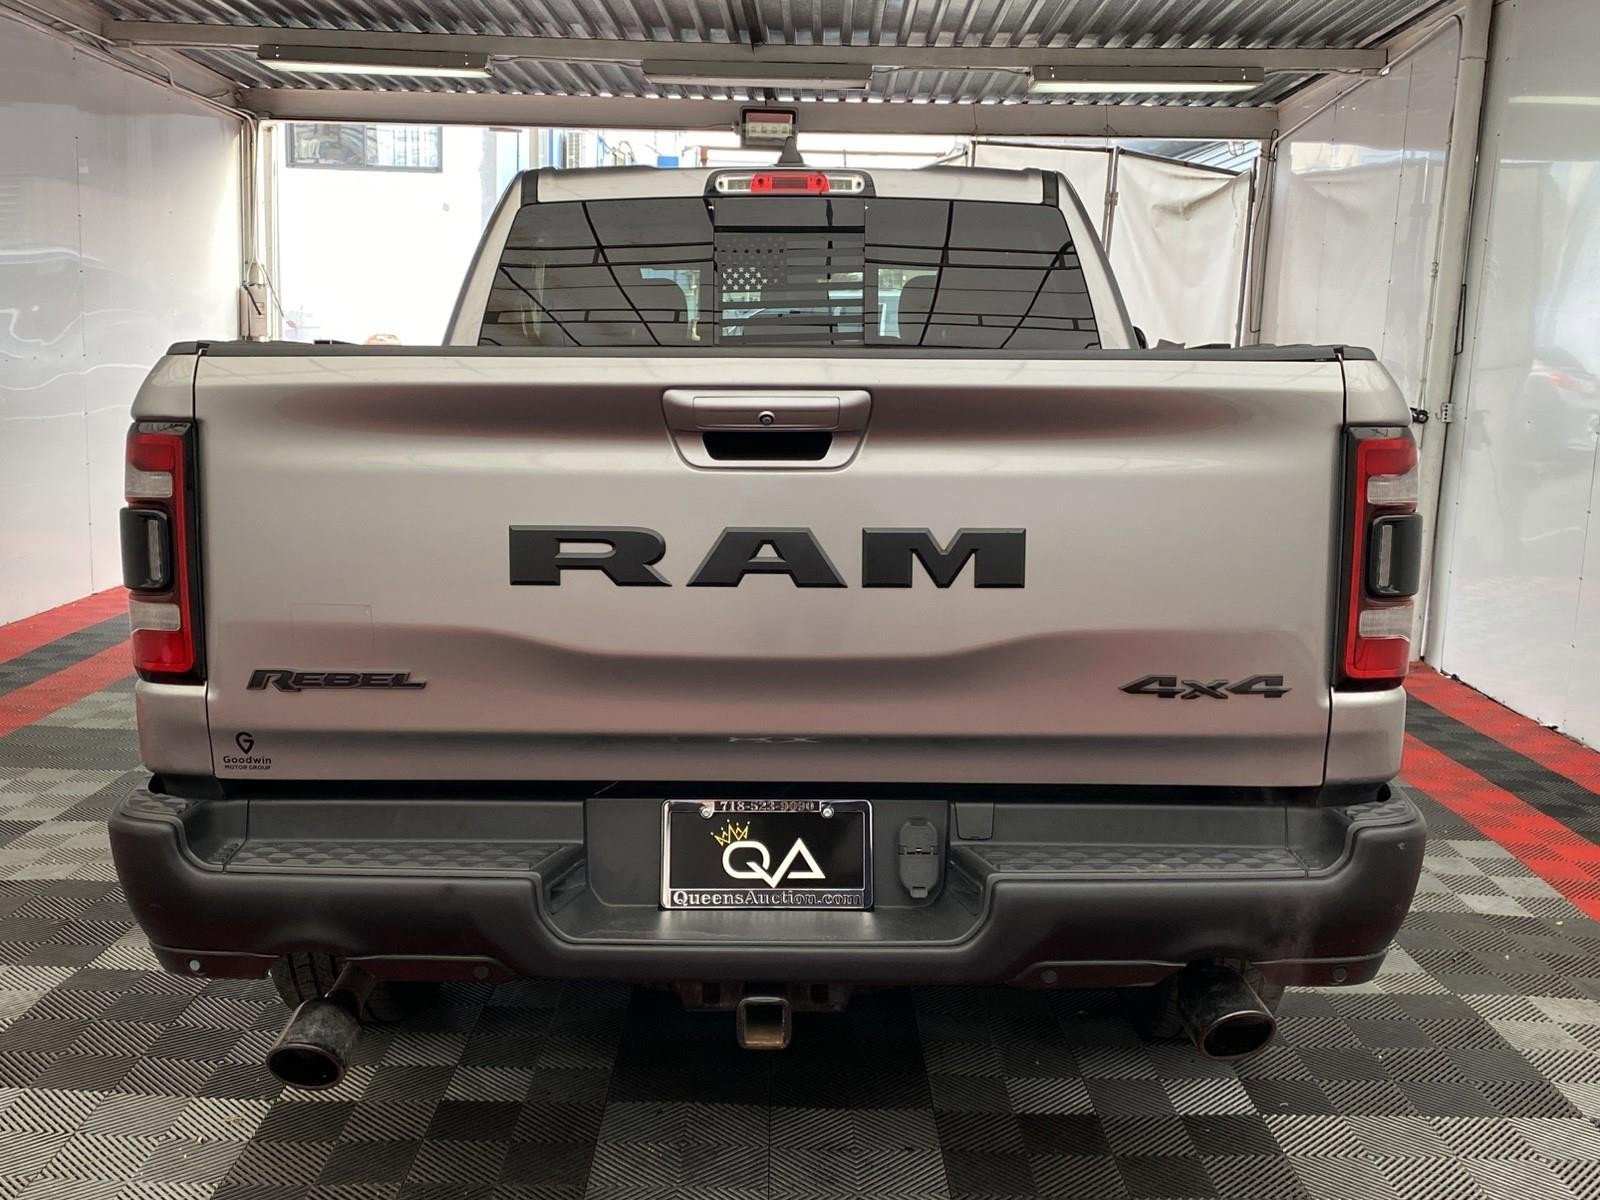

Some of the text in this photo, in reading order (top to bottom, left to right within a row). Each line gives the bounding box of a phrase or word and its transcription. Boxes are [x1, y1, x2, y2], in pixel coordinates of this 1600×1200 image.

[509, 525, 1026, 588] RAM
[247, 669, 427, 692] REBEL
[235, 732, 254, 754] G
[223, 755, 271, 764] Goodwin
[722, 837, 826, 888] QA
[673, 889, 861, 906] QueensAuction.com
